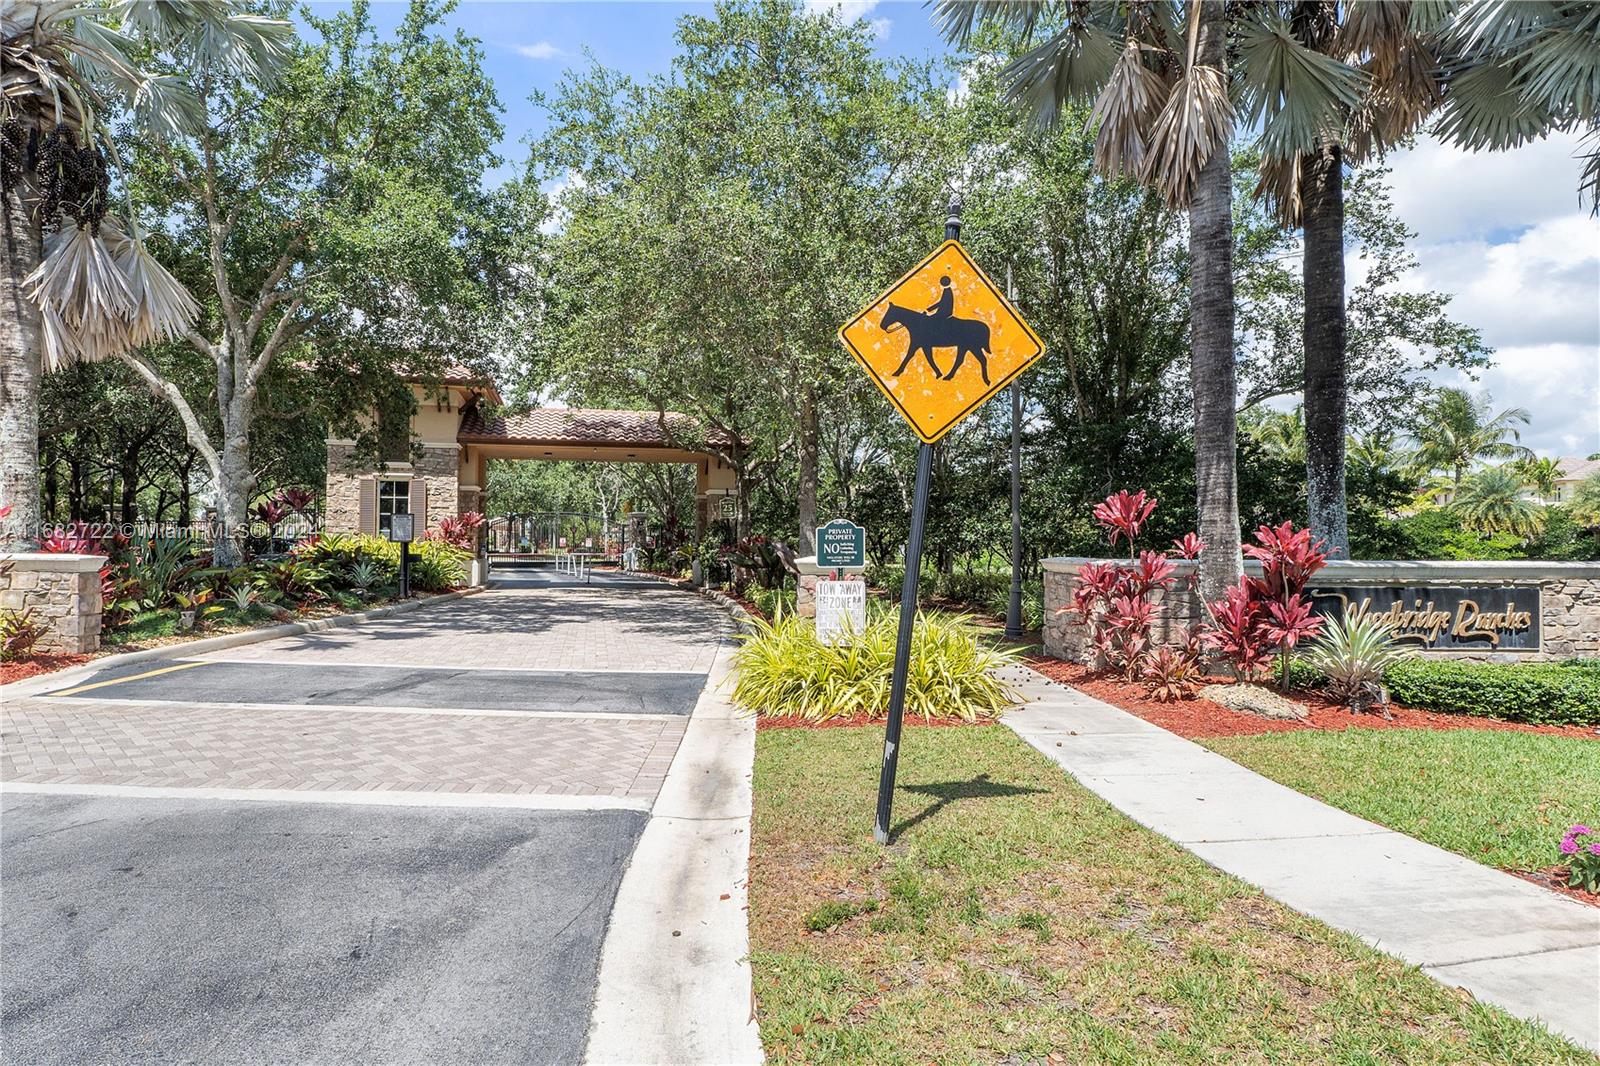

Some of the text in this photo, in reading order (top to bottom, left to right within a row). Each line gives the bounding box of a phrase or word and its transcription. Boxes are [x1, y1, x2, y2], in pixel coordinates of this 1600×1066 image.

[722, 504, 733, 512] 25
[823, 543, 840, 554] NO
[820, 583, 862, 595] TOW AWAY
[829, 596, 851, 608] ZONE
[1453, 599, 1531, 645] Ranches
